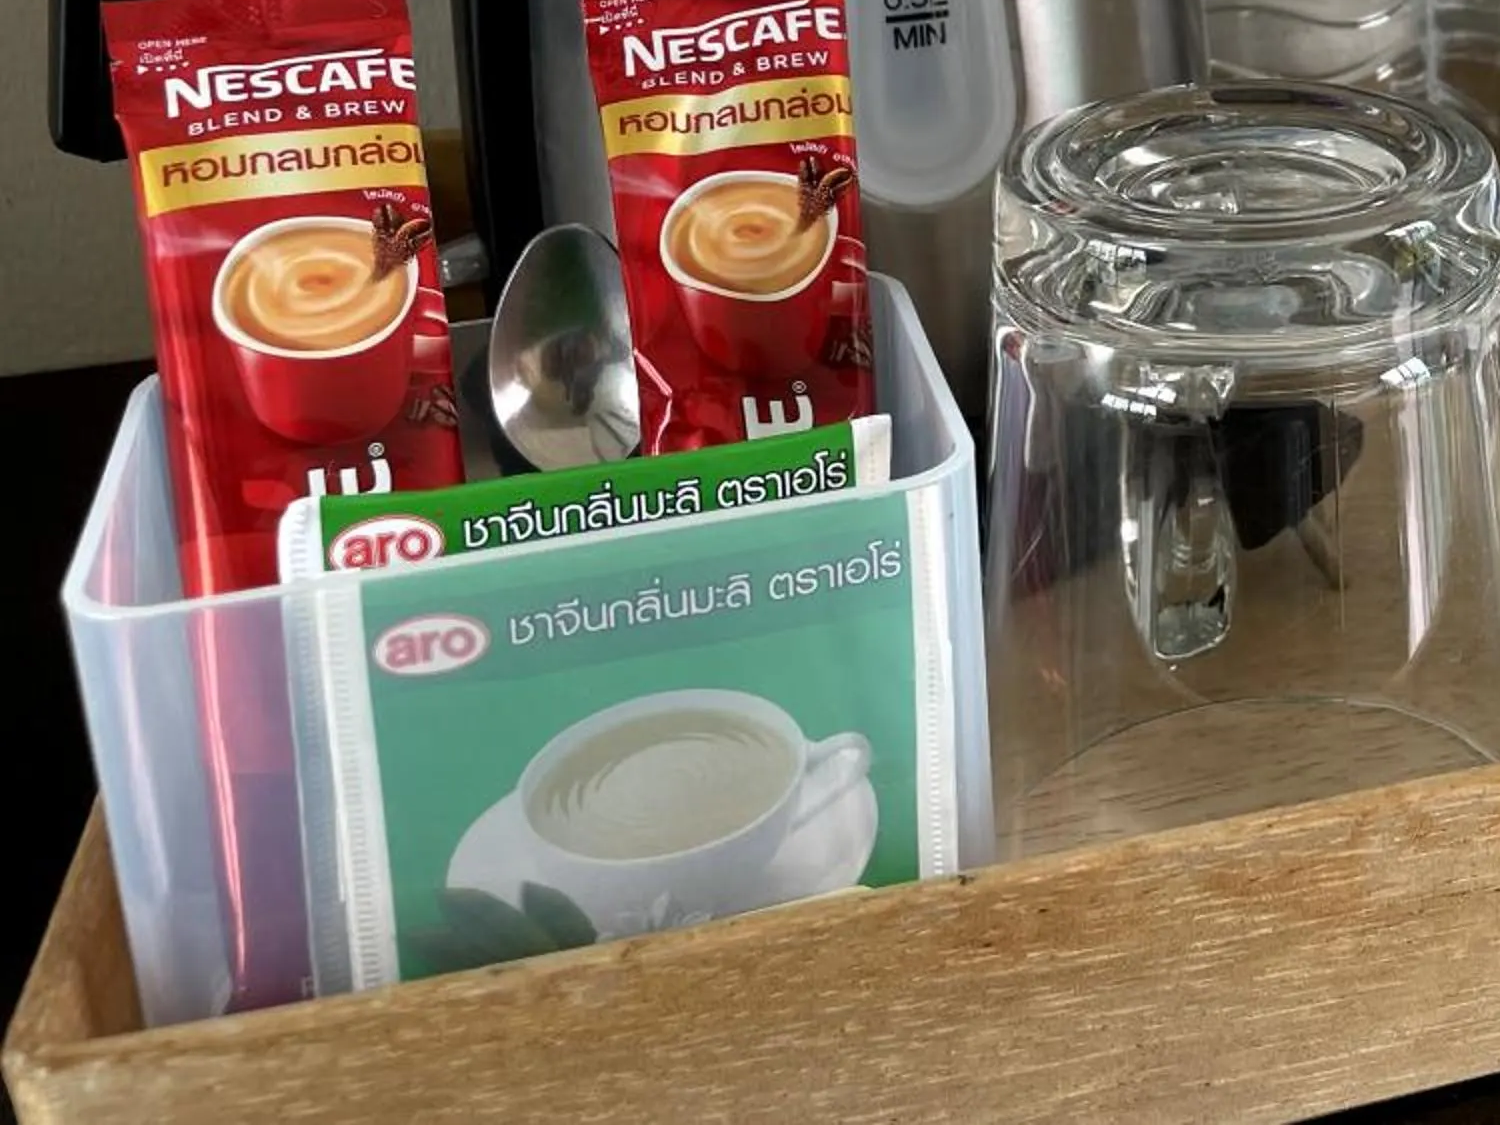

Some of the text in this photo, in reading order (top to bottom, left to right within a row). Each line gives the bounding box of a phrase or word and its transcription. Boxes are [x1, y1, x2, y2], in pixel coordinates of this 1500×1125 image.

[138, 40, 171, 50] OPEN
[893, 22, 947, 51] MIN
[641, 51, 829, 90] BLEND & BREW
[188, 100, 405, 137] BLEND & BREW
[463, 477, 701, 549] ชาจีนกลิ่นมะลิ
[717, 451, 848, 508] ตราเอโร่
[344, 528, 432, 569] aro
[510, 540, 902, 645] ชาจีนกลิ่นมะลิ ตราเอโร่
[385, 625, 478, 669] aro
